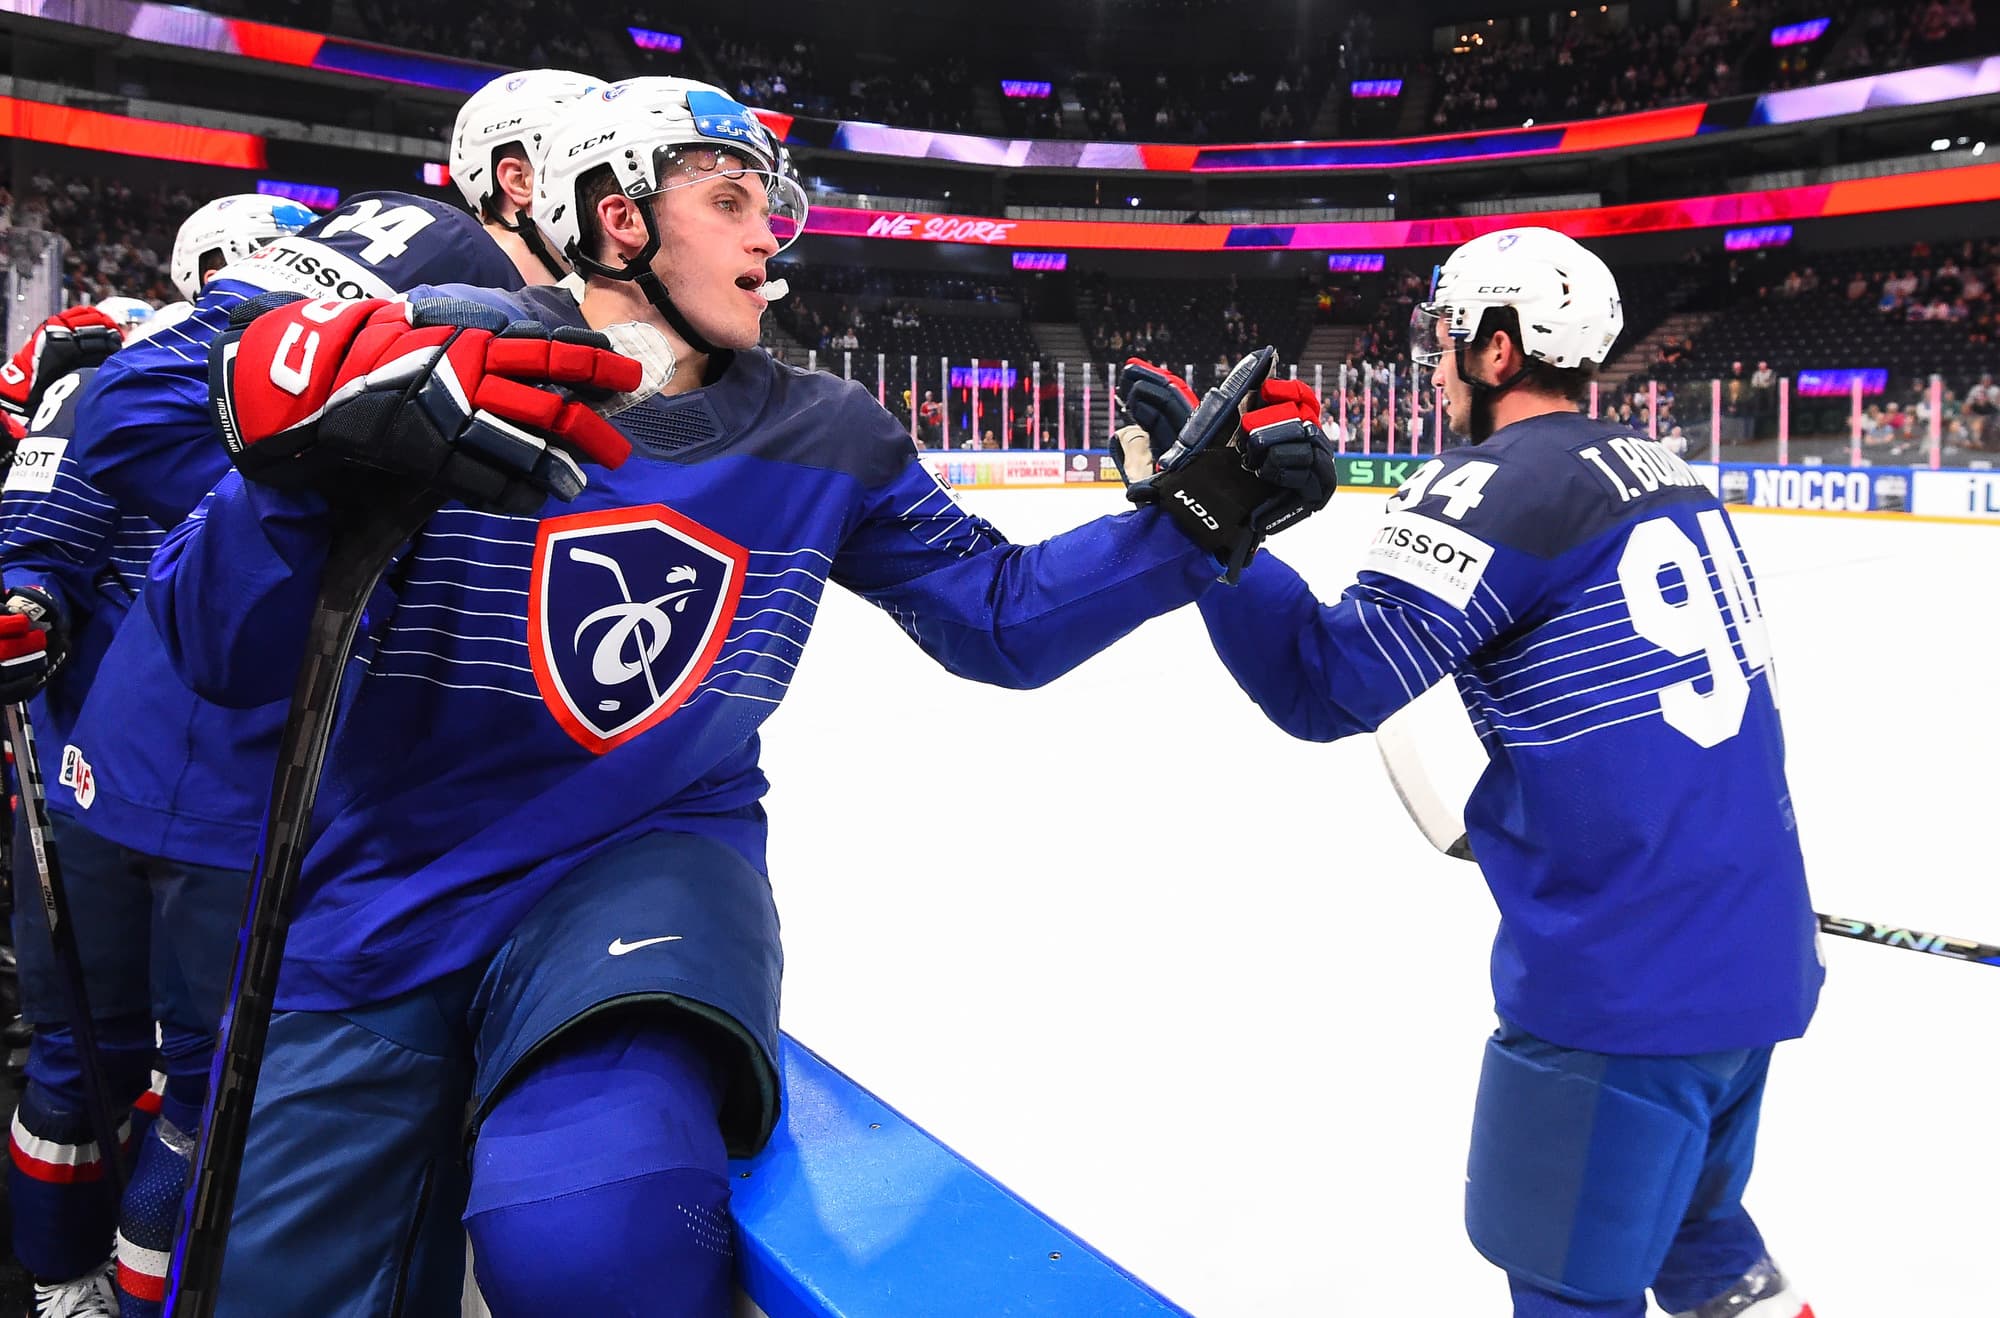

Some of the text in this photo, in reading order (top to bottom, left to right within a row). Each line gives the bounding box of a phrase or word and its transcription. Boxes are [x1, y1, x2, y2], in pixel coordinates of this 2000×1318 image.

[483, 117, 523, 134] CCM
[568, 130, 616, 158] CCM
[867, 215, 1017, 242] WE SCORE
[1478, 286, 1522, 294] CCM
[1173, 489, 1220, 531] CCM
[1752, 468, 1870, 512] NOCCO
[1378, 526, 1478, 574] TISSOT
[1616, 509, 1780, 749] 94
[1822, 914, 1979, 960] SYNC
